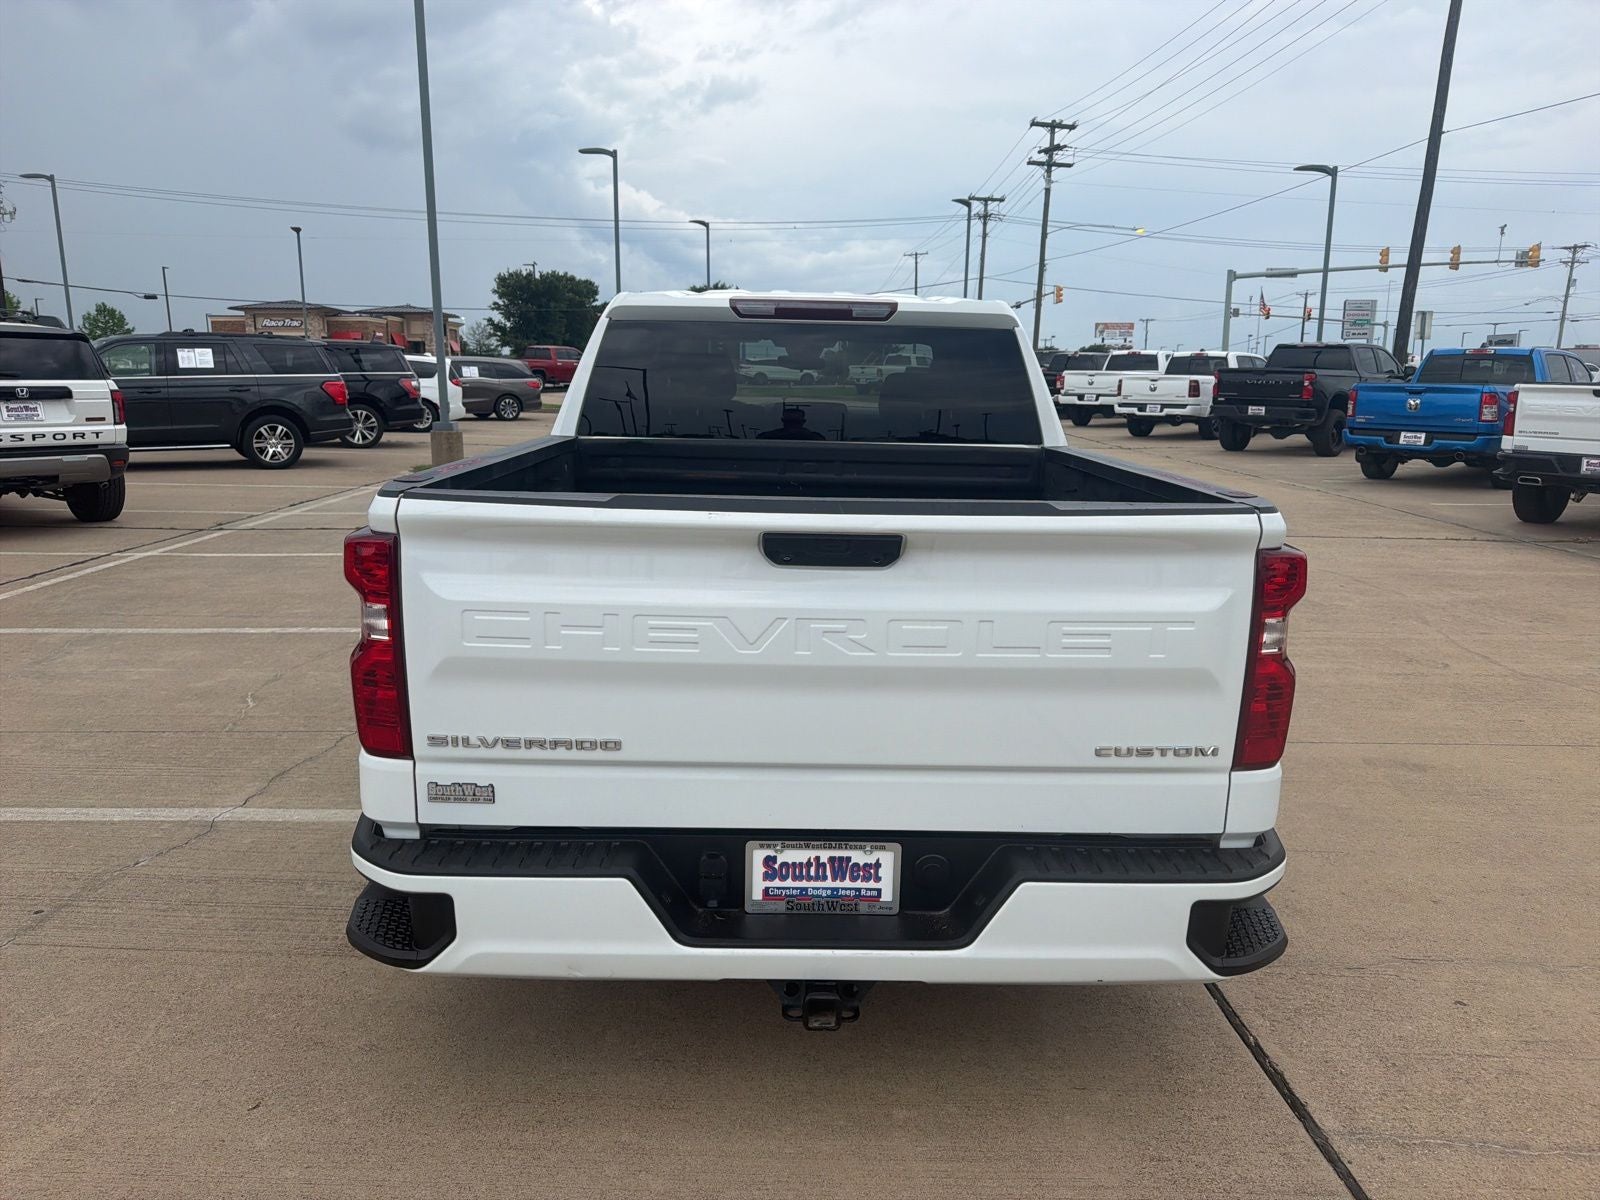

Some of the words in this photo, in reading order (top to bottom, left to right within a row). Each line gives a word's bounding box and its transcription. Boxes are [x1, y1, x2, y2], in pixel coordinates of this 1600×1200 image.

[0, 432, 104, 443] SPORT
[1586, 460, 1600, 468] Sout
[461, 609, 1196, 657] CHEVROLET
[427, 734, 622, 751] SILVERADO
[1094, 745, 1219, 757] CUSTOM
[427, 782, 494, 796] SouthWest
[758, 842, 887, 850] wwwSouthWestCDJRTexascom
[762, 855, 882, 883] SouthWest
[769, 888, 801, 897] Chrysler
[808, 888, 832, 897] Dodge
[838, 888, 856, 897] Jeep
[786, 900, 860, 912] SouthWest
